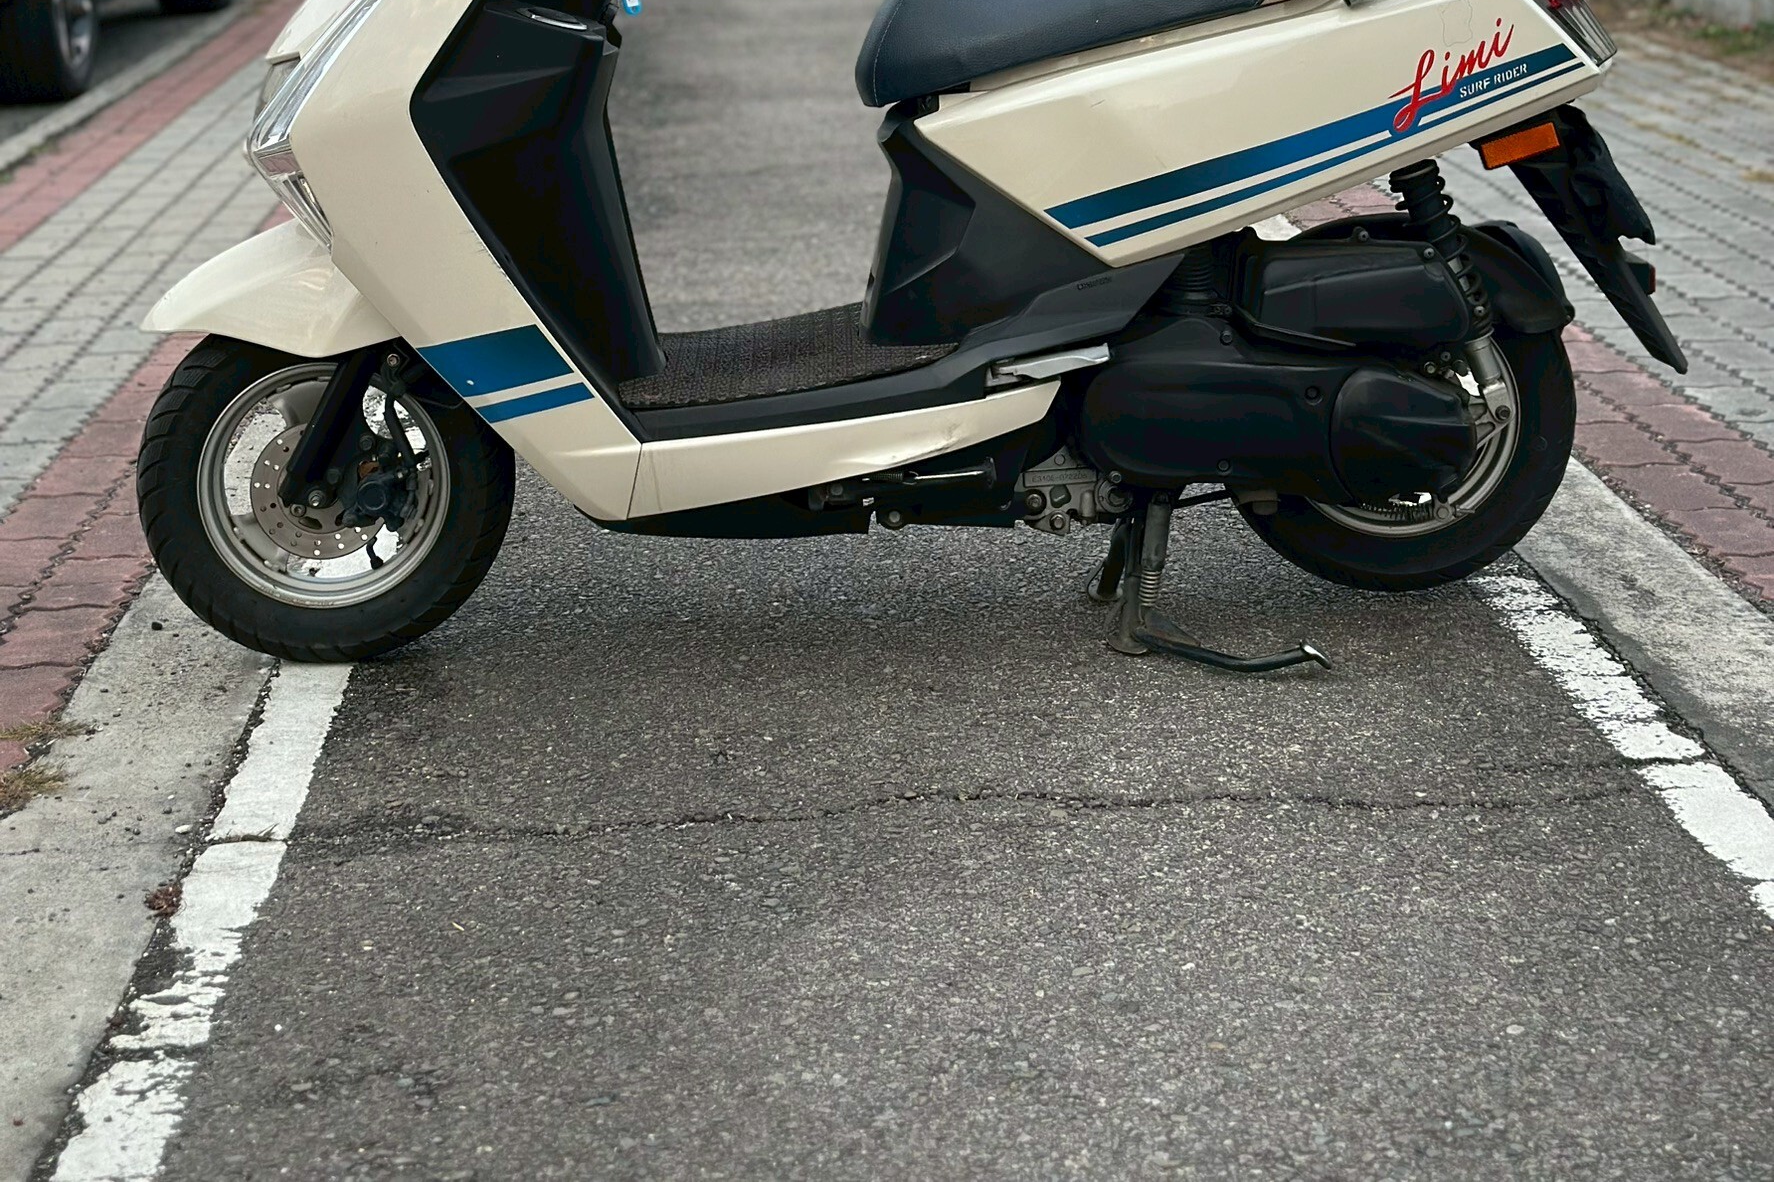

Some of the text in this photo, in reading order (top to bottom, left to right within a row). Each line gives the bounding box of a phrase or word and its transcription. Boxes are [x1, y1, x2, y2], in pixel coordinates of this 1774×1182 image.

[1388, 18, 1514, 132] Limi
[1459, 63, 1528, 98] SURF RIDER
